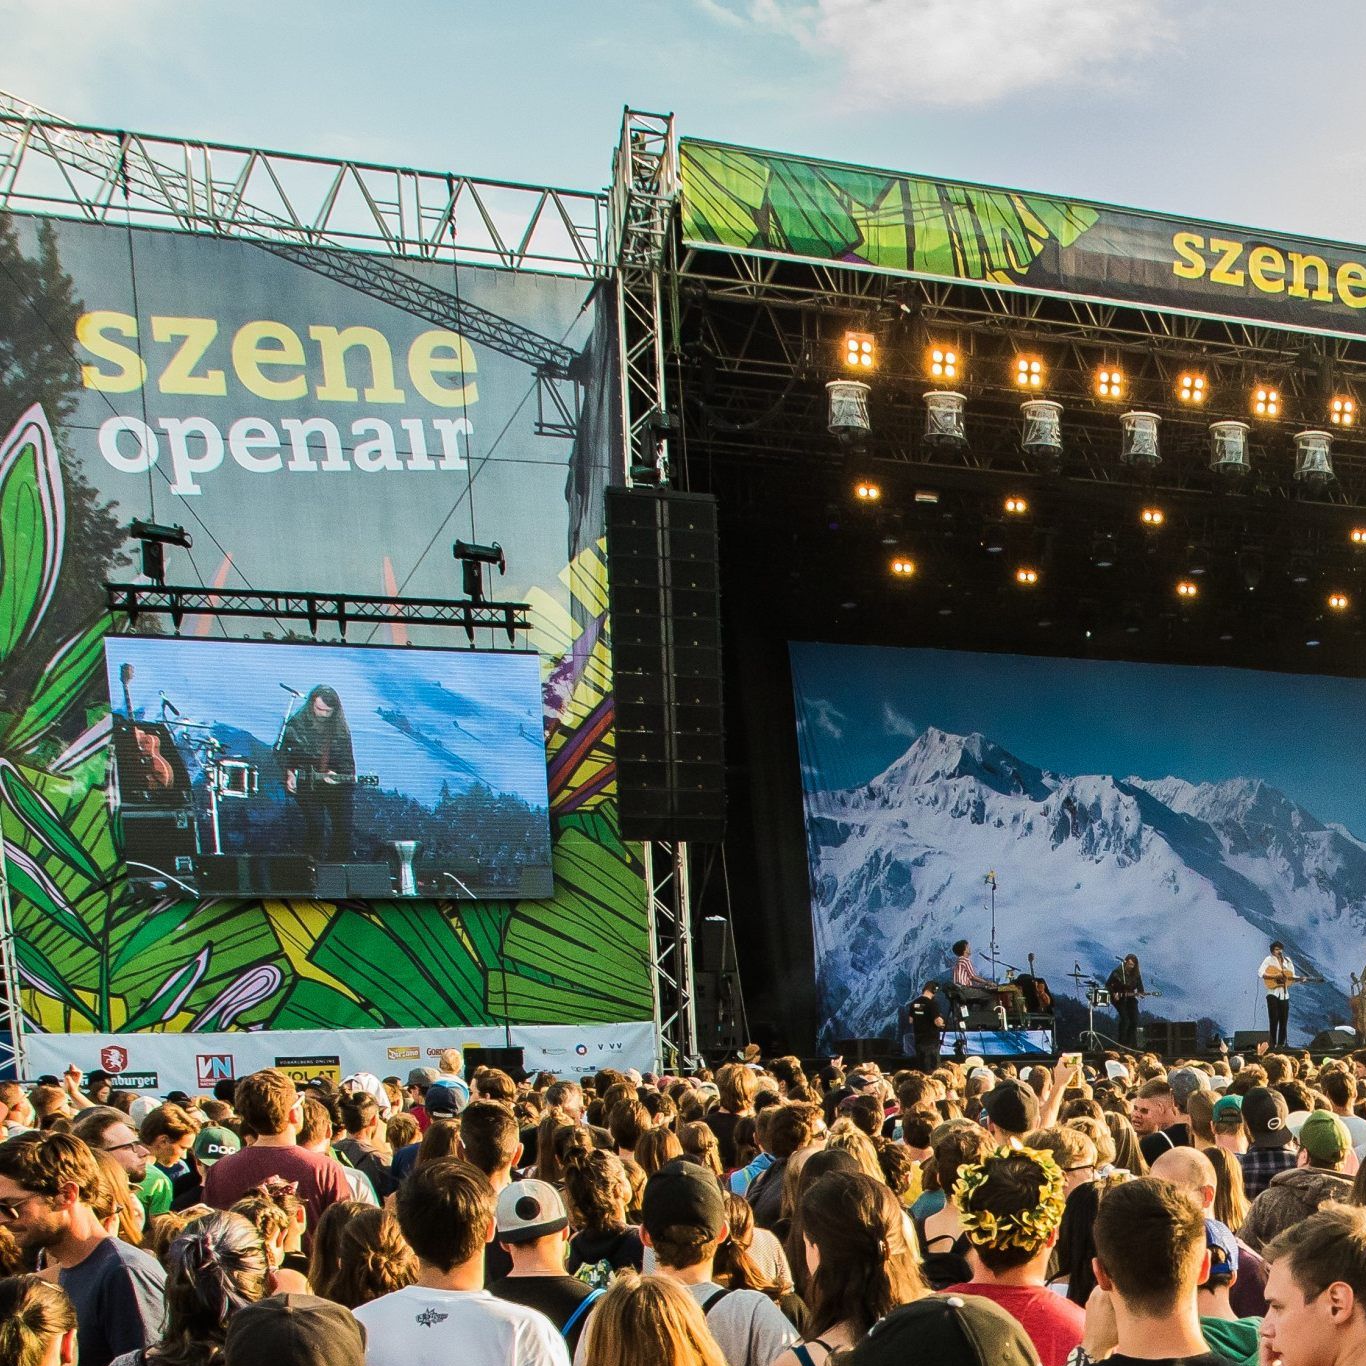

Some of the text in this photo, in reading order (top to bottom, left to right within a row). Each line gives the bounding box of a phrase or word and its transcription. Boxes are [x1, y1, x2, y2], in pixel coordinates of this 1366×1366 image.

[75, 311, 480, 407] szene
[98, 413, 473, 495] openair
[198, 1057, 232, 1078] VN
